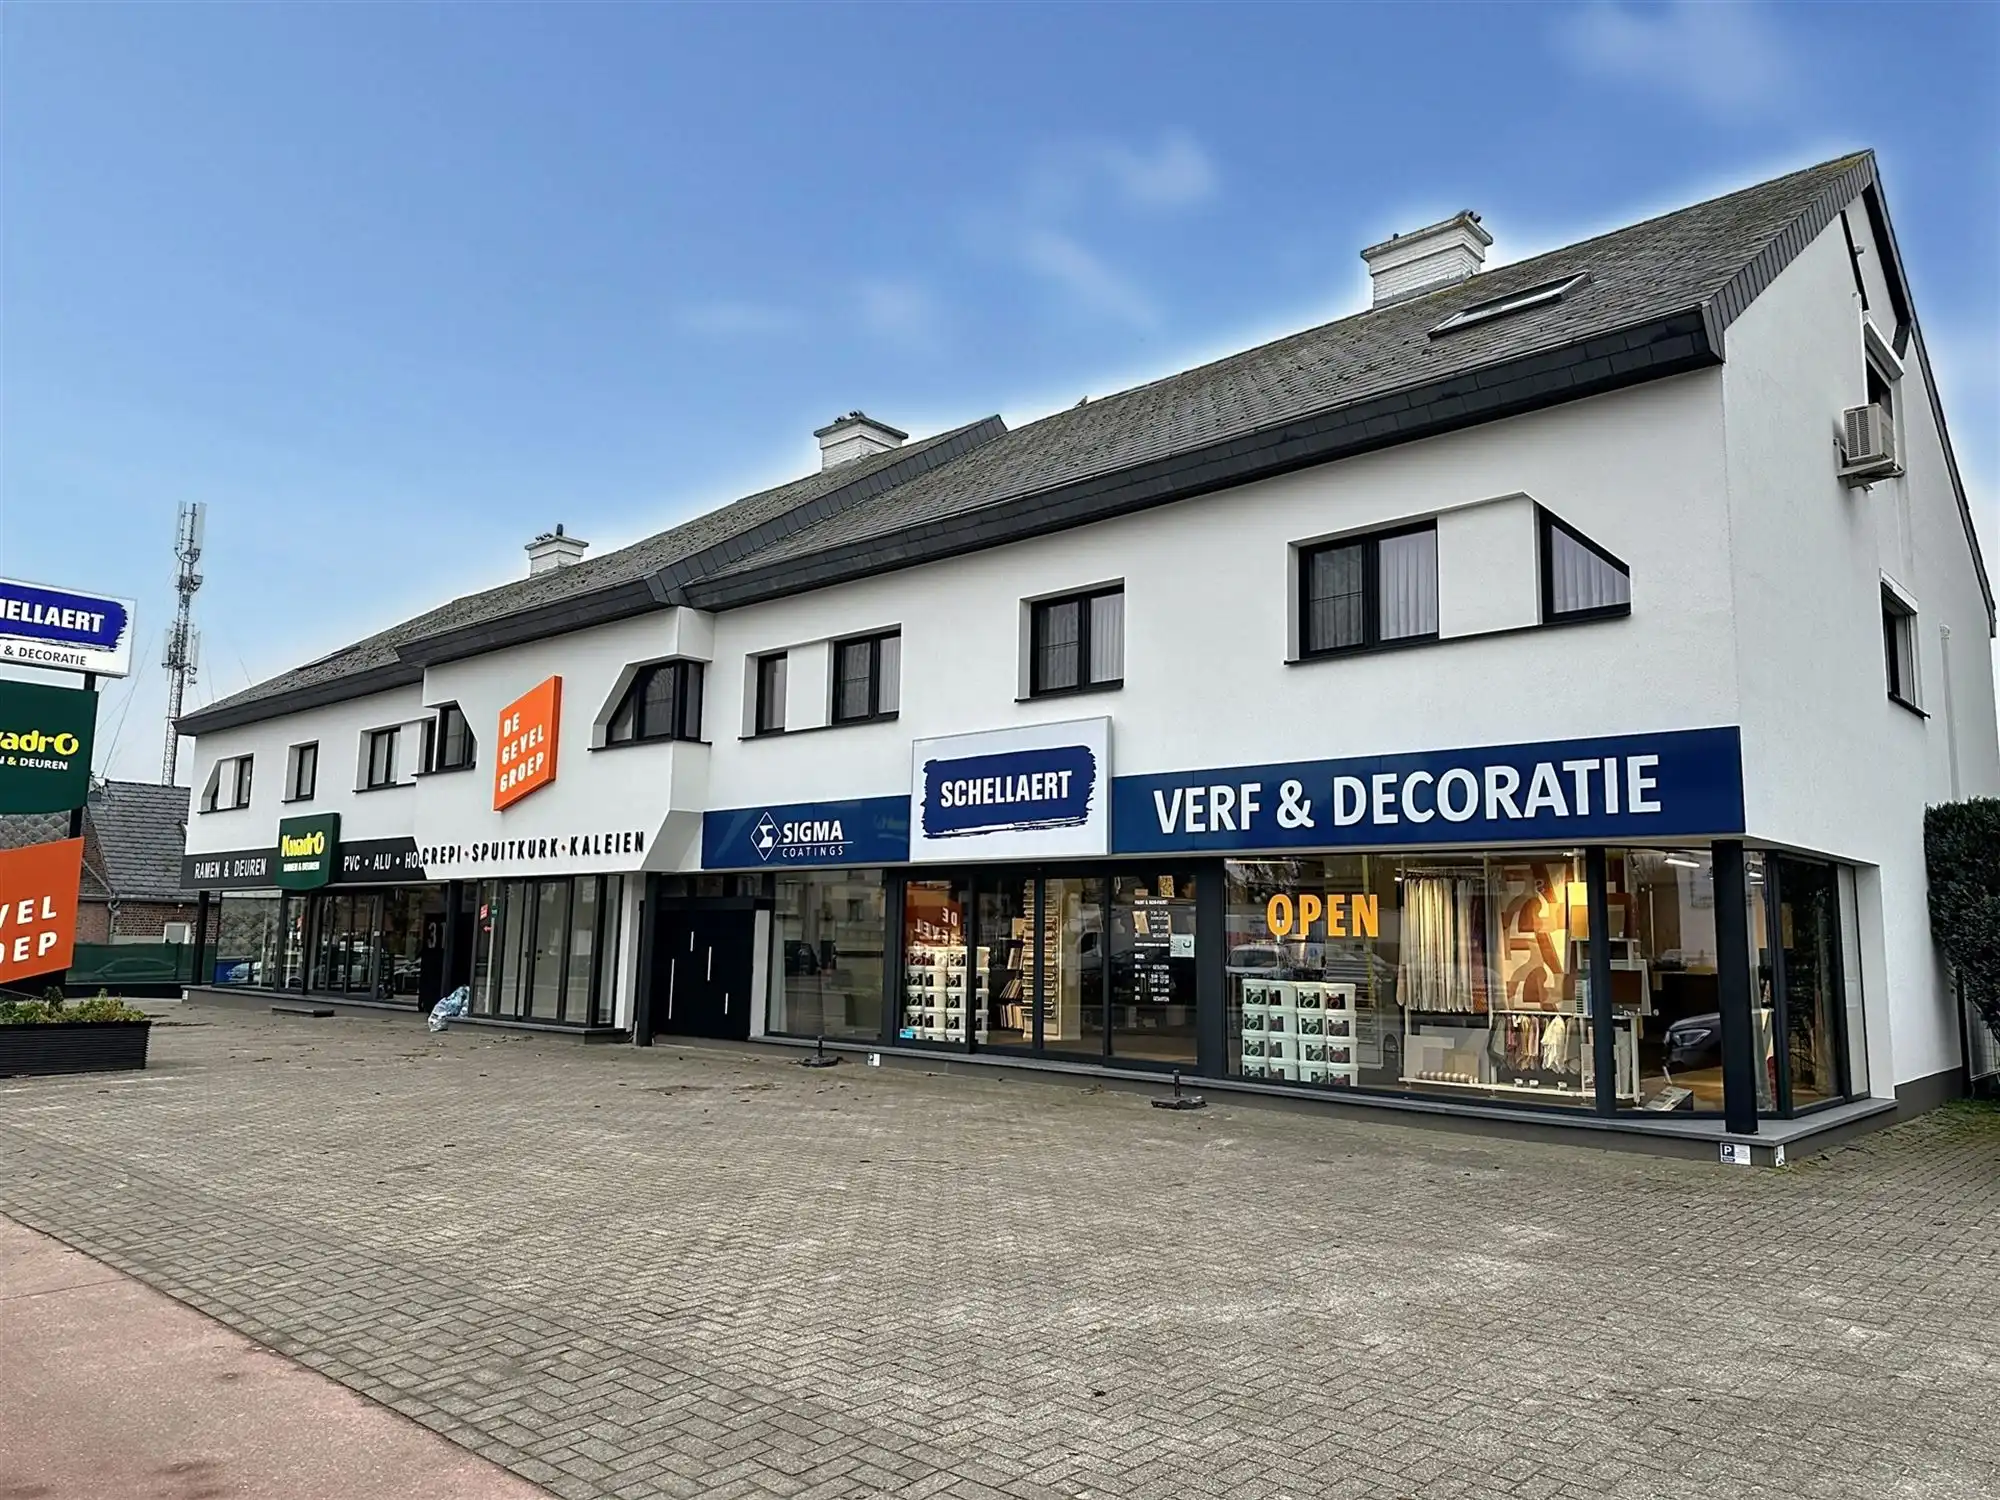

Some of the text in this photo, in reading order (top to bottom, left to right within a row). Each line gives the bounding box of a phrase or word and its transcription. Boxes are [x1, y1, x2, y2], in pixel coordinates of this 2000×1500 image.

[4, 645, 87, 666] & DECORATIE
[503, 712, 520, 738] DE
[501, 724, 545, 765] GEVEL
[7, 756, 17, 766] &
[19, 757, 68, 771] DEUREN
[499, 751, 545, 793] GROEP
[940, 770, 1072, 808] SCHELLAERT
[1153, 754, 1661, 834] VERF & DECORATIE
[783, 820, 844, 843] SIGMA
[422, 831, 644, 866] CREPI SPUITKURK KALEIEN
[782, 845, 843, 858] COATINGS
[194, 858, 267, 879] RAMEN & DEUREN
[343, 855, 360, 871] PVC
[373, 853, 391, 870] ALU
[1267, 893, 1379, 938] OPEN
